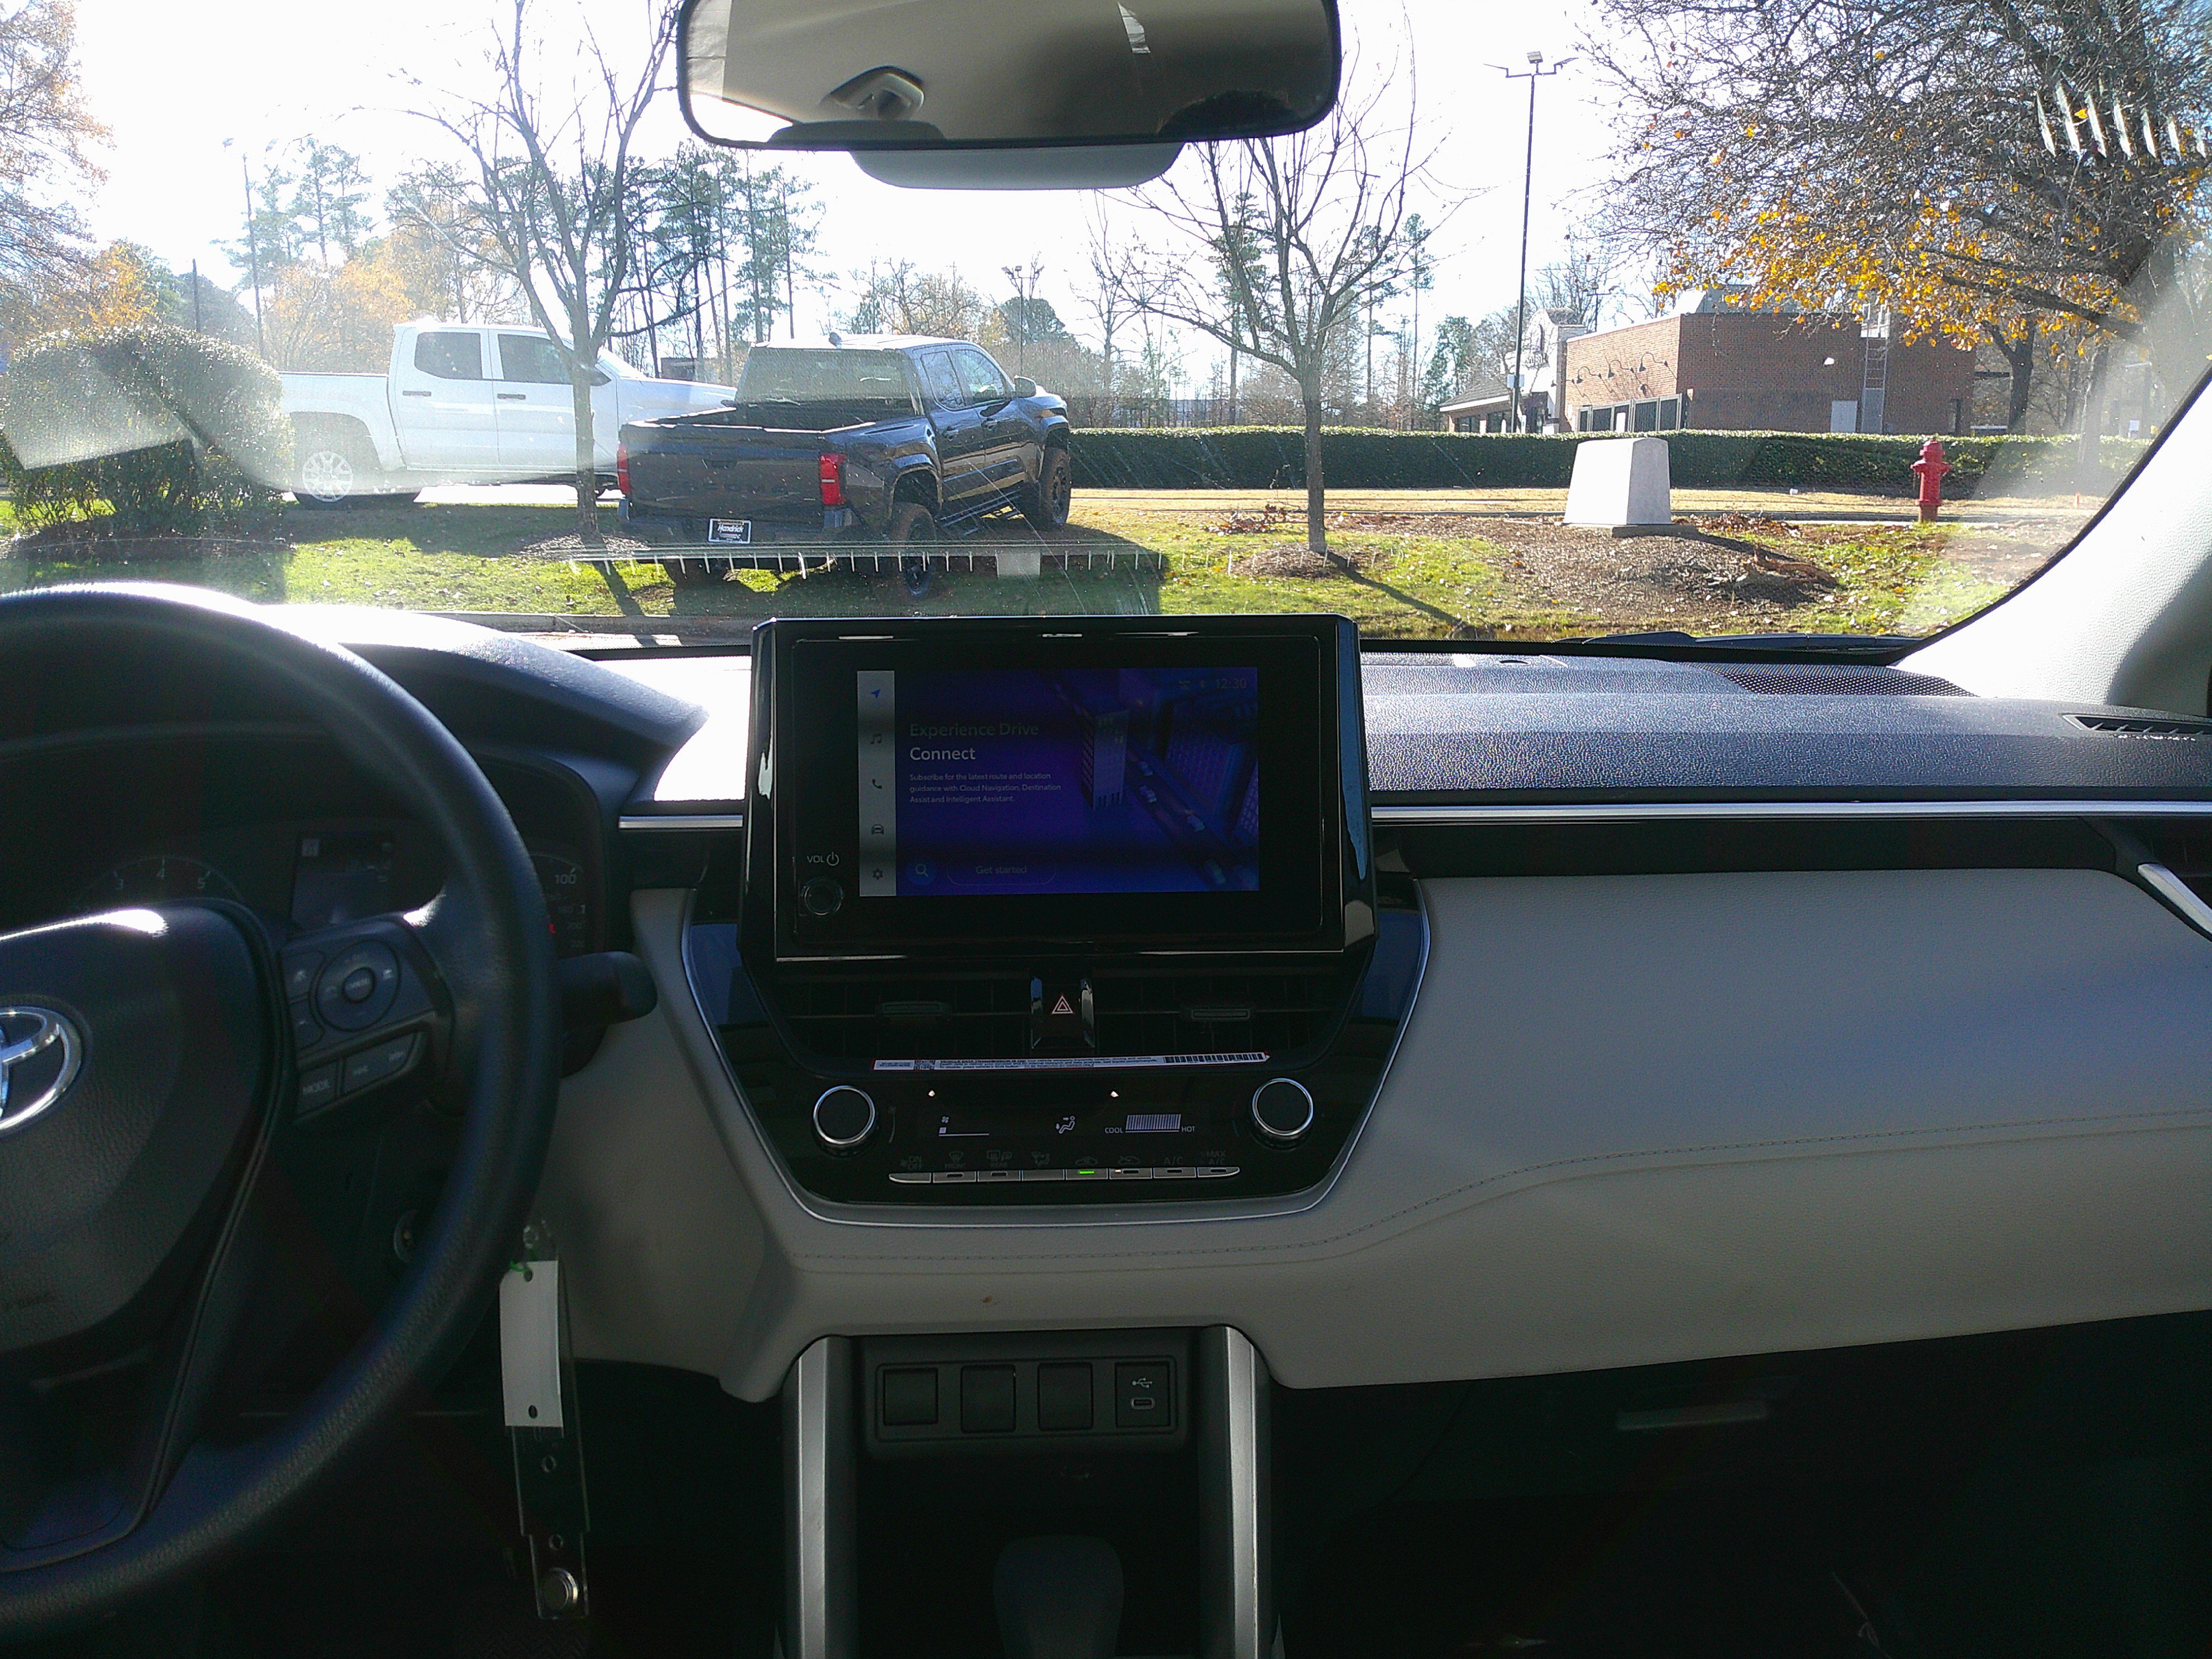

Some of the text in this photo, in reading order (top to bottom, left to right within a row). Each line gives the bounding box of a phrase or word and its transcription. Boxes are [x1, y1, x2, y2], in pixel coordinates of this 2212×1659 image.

[717, 524, 744, 533] Hendrick
[1215, 677, 1247, 689] 12:30
[910, 723, 1039, 739] Experience Drive
[910, 747, 976, 761] Connect
[946, 796, 981, 804] Intelligent
[807, 855, 825, 863] VOL
[156, 868, 165, 880] 4
[975, 865, 1027, 874] Get started
[197, 878, 206, 889] 5
[555, 874, 576, 884] 100
[116, 879, 124, 890] 3
[1163, 1156, 1183, 1165] A/C
